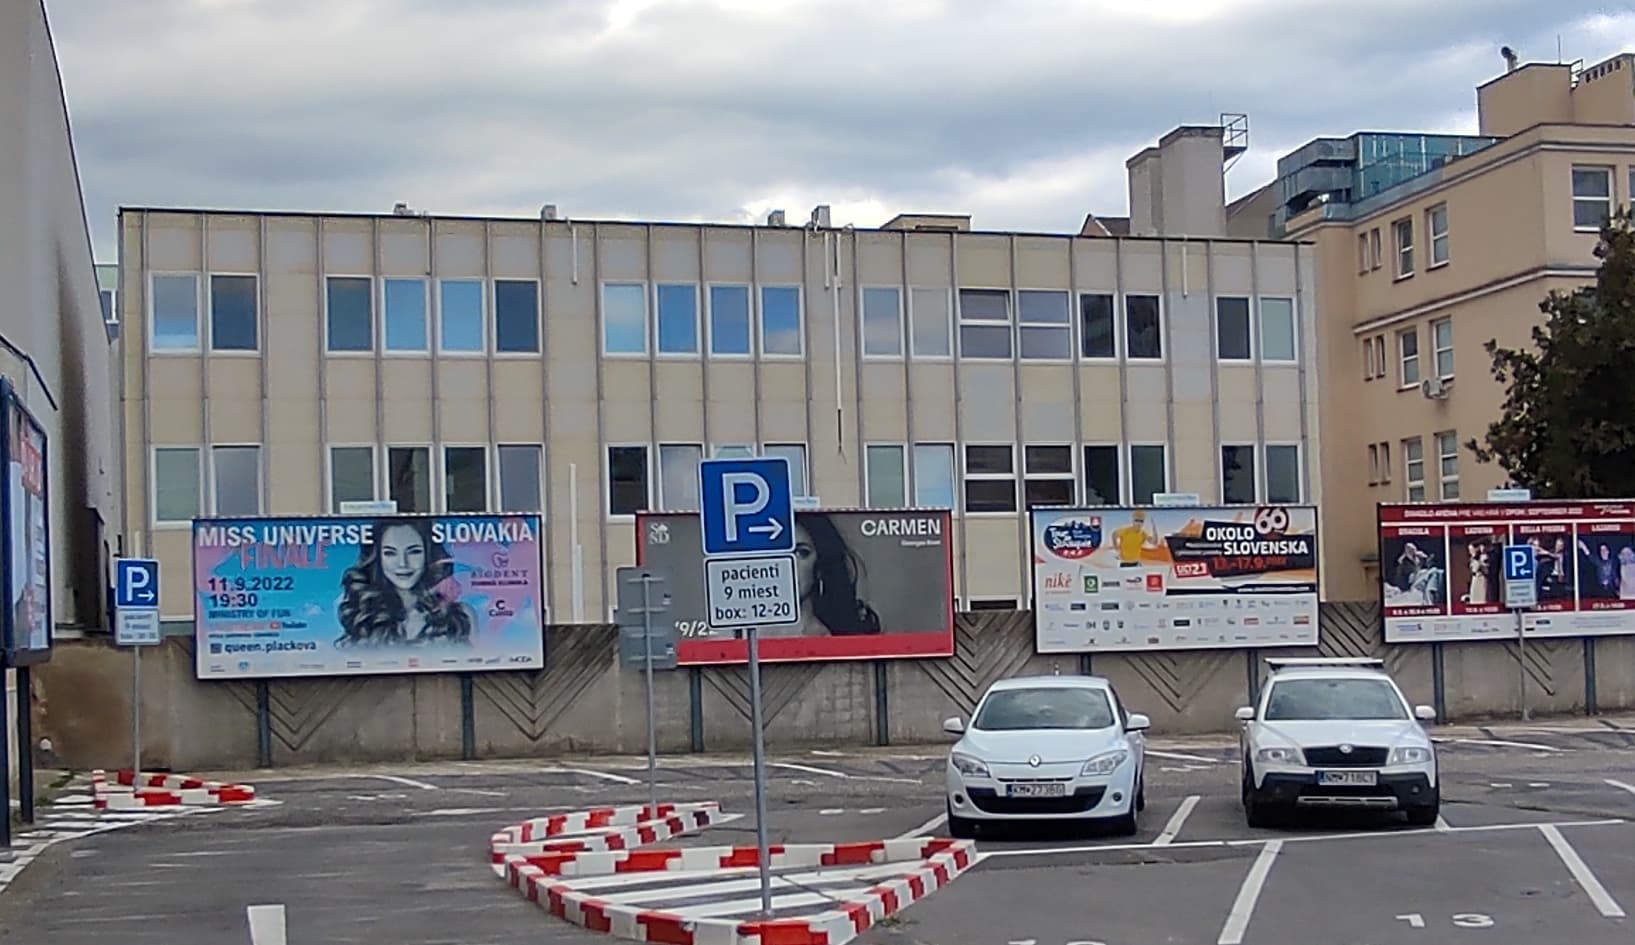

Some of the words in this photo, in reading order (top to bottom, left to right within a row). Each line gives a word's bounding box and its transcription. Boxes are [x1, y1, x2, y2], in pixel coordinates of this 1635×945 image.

[722, 472, 770, 542] P
[860, 518, 941, 536] CARMEN
[1255, 507, 1288, 535] 60
[199, 526, 257, 546] MISS
[263, 524, 374, 545] UNIVERSE
[431, 522, 534, 543] SLOVAKIA
[1206, 526, 1255, 541] OKOLO
[241, 540, 329, 570] FINALE
[1223, 540, 1309, 555] SLOVENSKA
[1511, 551, 1527, 576] P
[721, 564, 780, 583] pacienti
[126, 566, 149, 602] P
[207, 576, 295, 591] 11.9.2022
[724, 586, 733, 600] 9
[738, 584, 779, 600] miest
[208, 593, 258, 608] 19:30
[715, 606, 746, 620] box:
[751, 602, 790, 618] 12-20
[225, 640, 317, 653] queen.plackova
